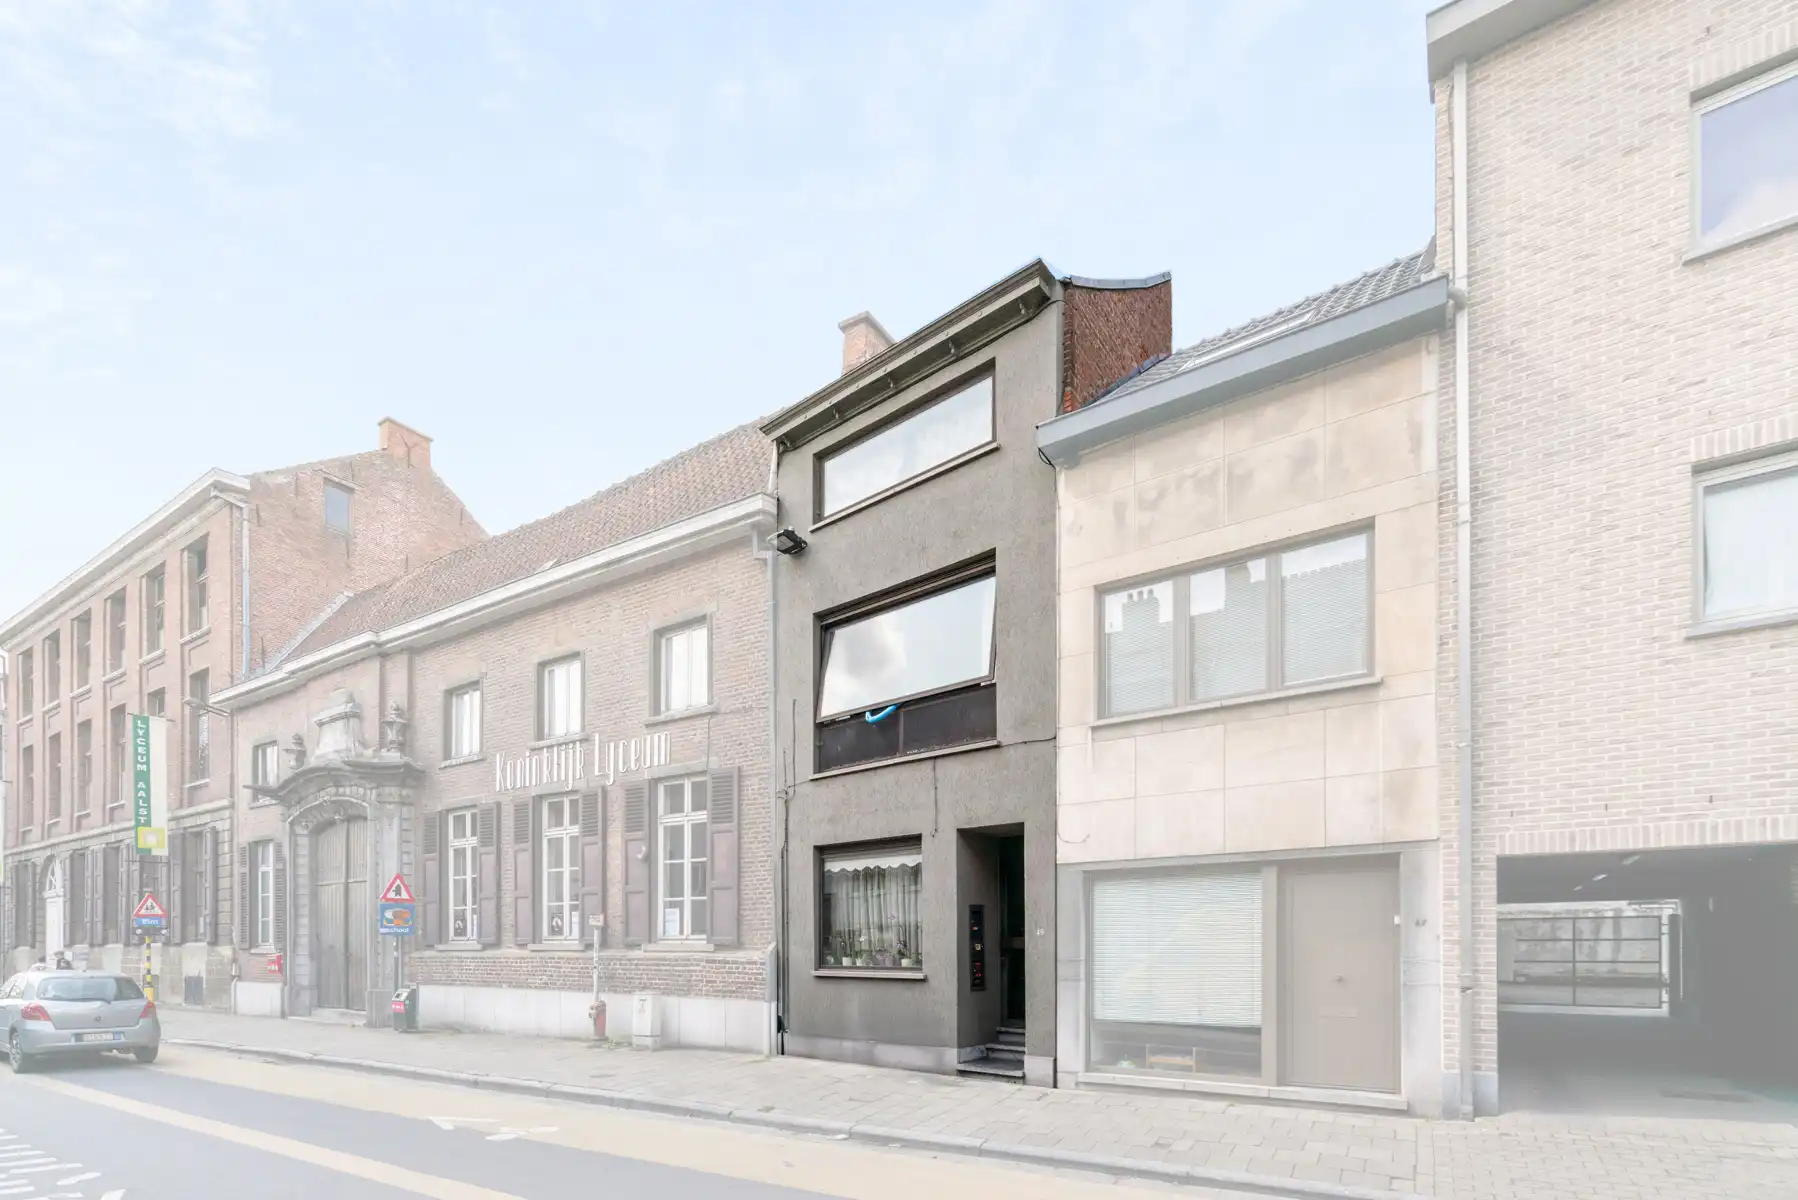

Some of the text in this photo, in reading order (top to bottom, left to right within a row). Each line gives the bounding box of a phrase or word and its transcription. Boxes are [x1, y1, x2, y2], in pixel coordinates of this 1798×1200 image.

[136, 719, 148, 824] LYCEUM AALST
[496, 732, 671, 792] Koninklijk Lyceum
